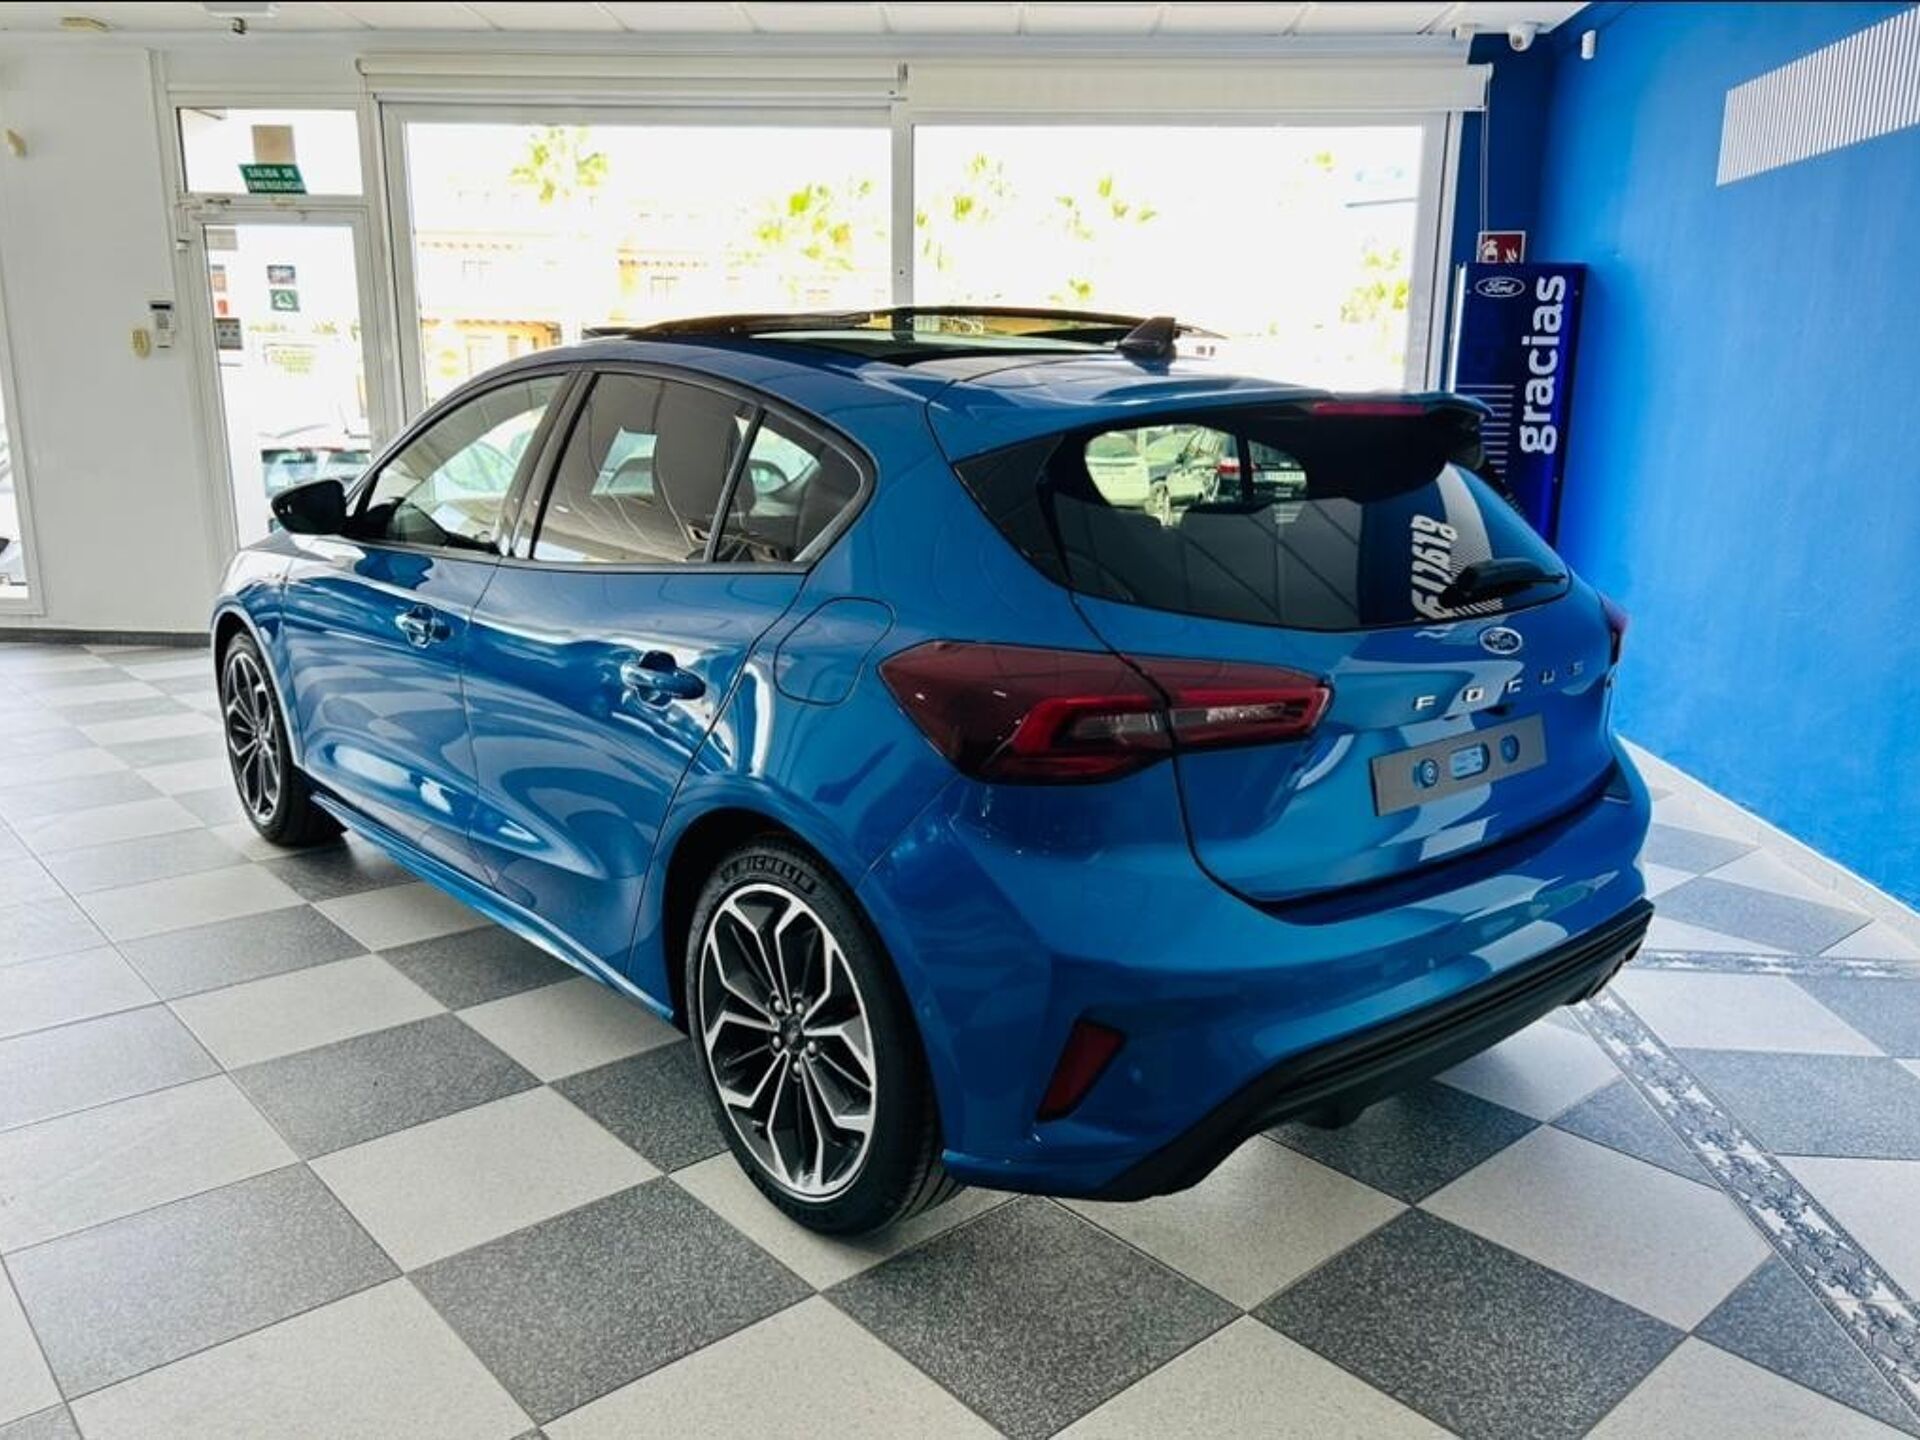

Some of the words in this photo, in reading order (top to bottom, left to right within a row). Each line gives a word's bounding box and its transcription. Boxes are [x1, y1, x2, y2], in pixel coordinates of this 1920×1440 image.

[1484, 280, 1516, 294] Ford
[1519, 275, 1567, 454] gracias
[1415, 660, 1584, 711] FOCUS
